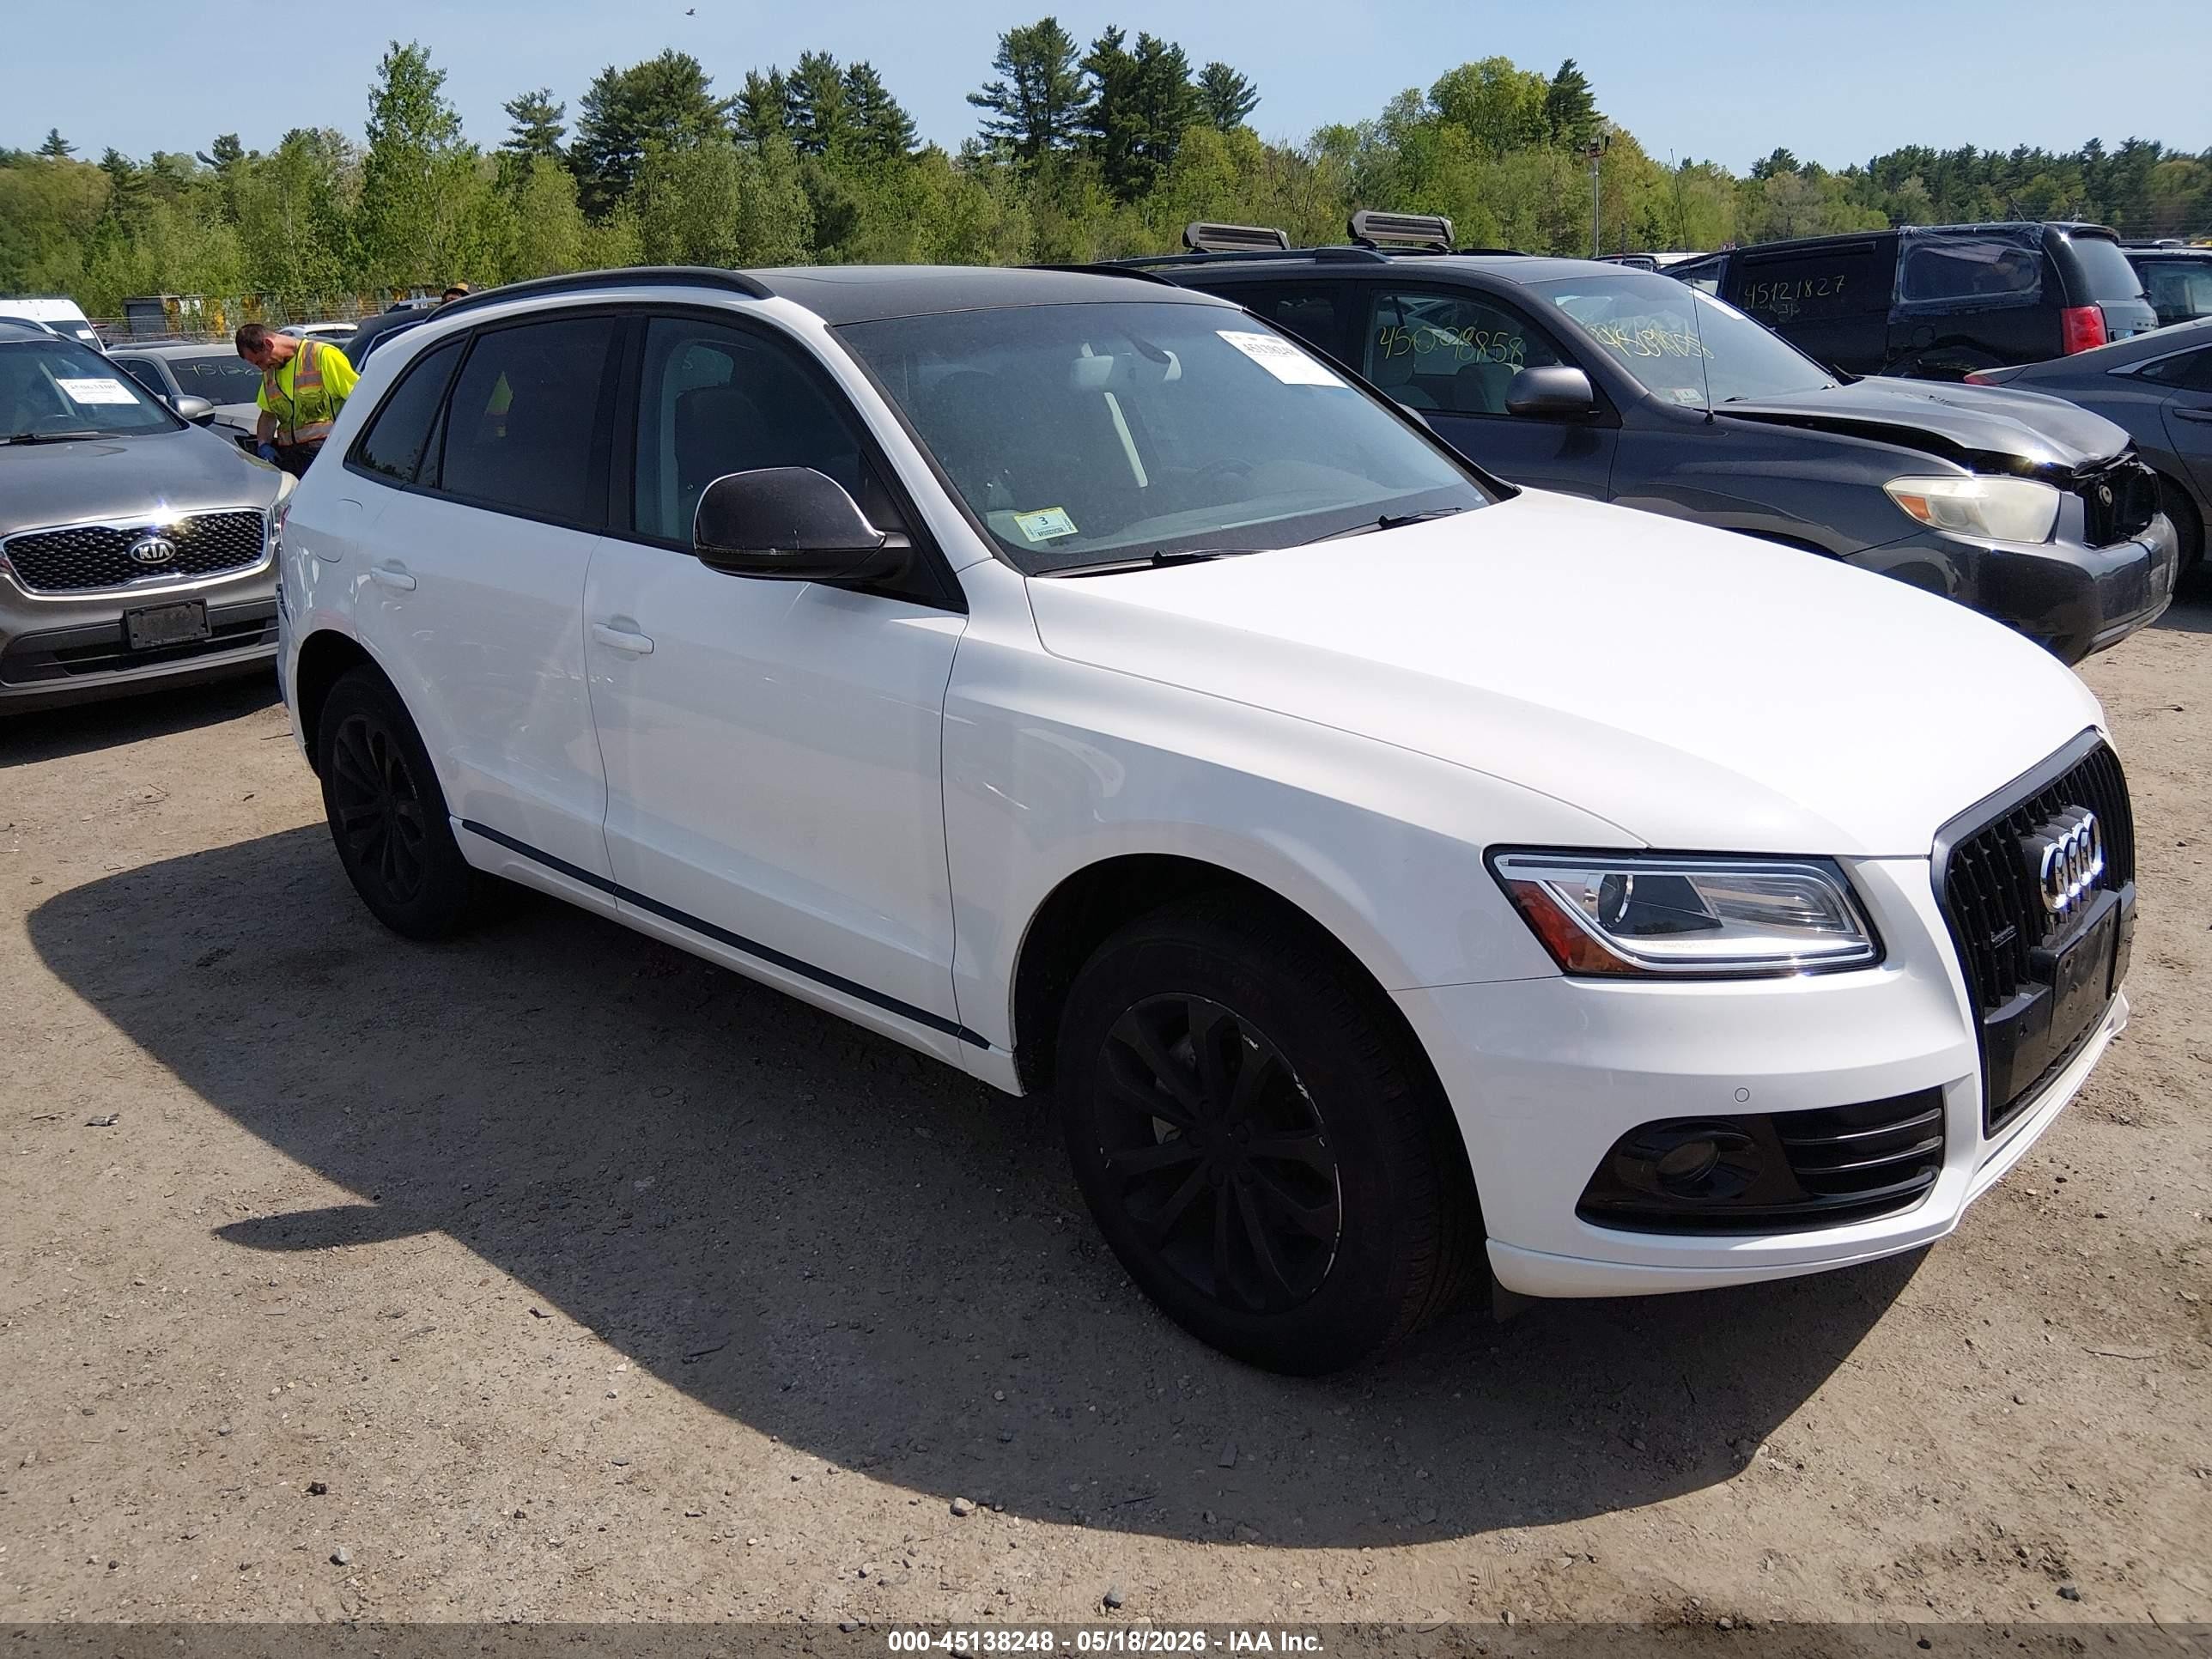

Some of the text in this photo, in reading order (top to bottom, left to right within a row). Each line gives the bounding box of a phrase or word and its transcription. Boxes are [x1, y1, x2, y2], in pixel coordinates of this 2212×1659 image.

[1745, 275, 1845, 310] 45121827
[1038, 516, 1048, 526] 3
[137, 544, 170, 559] KIA
